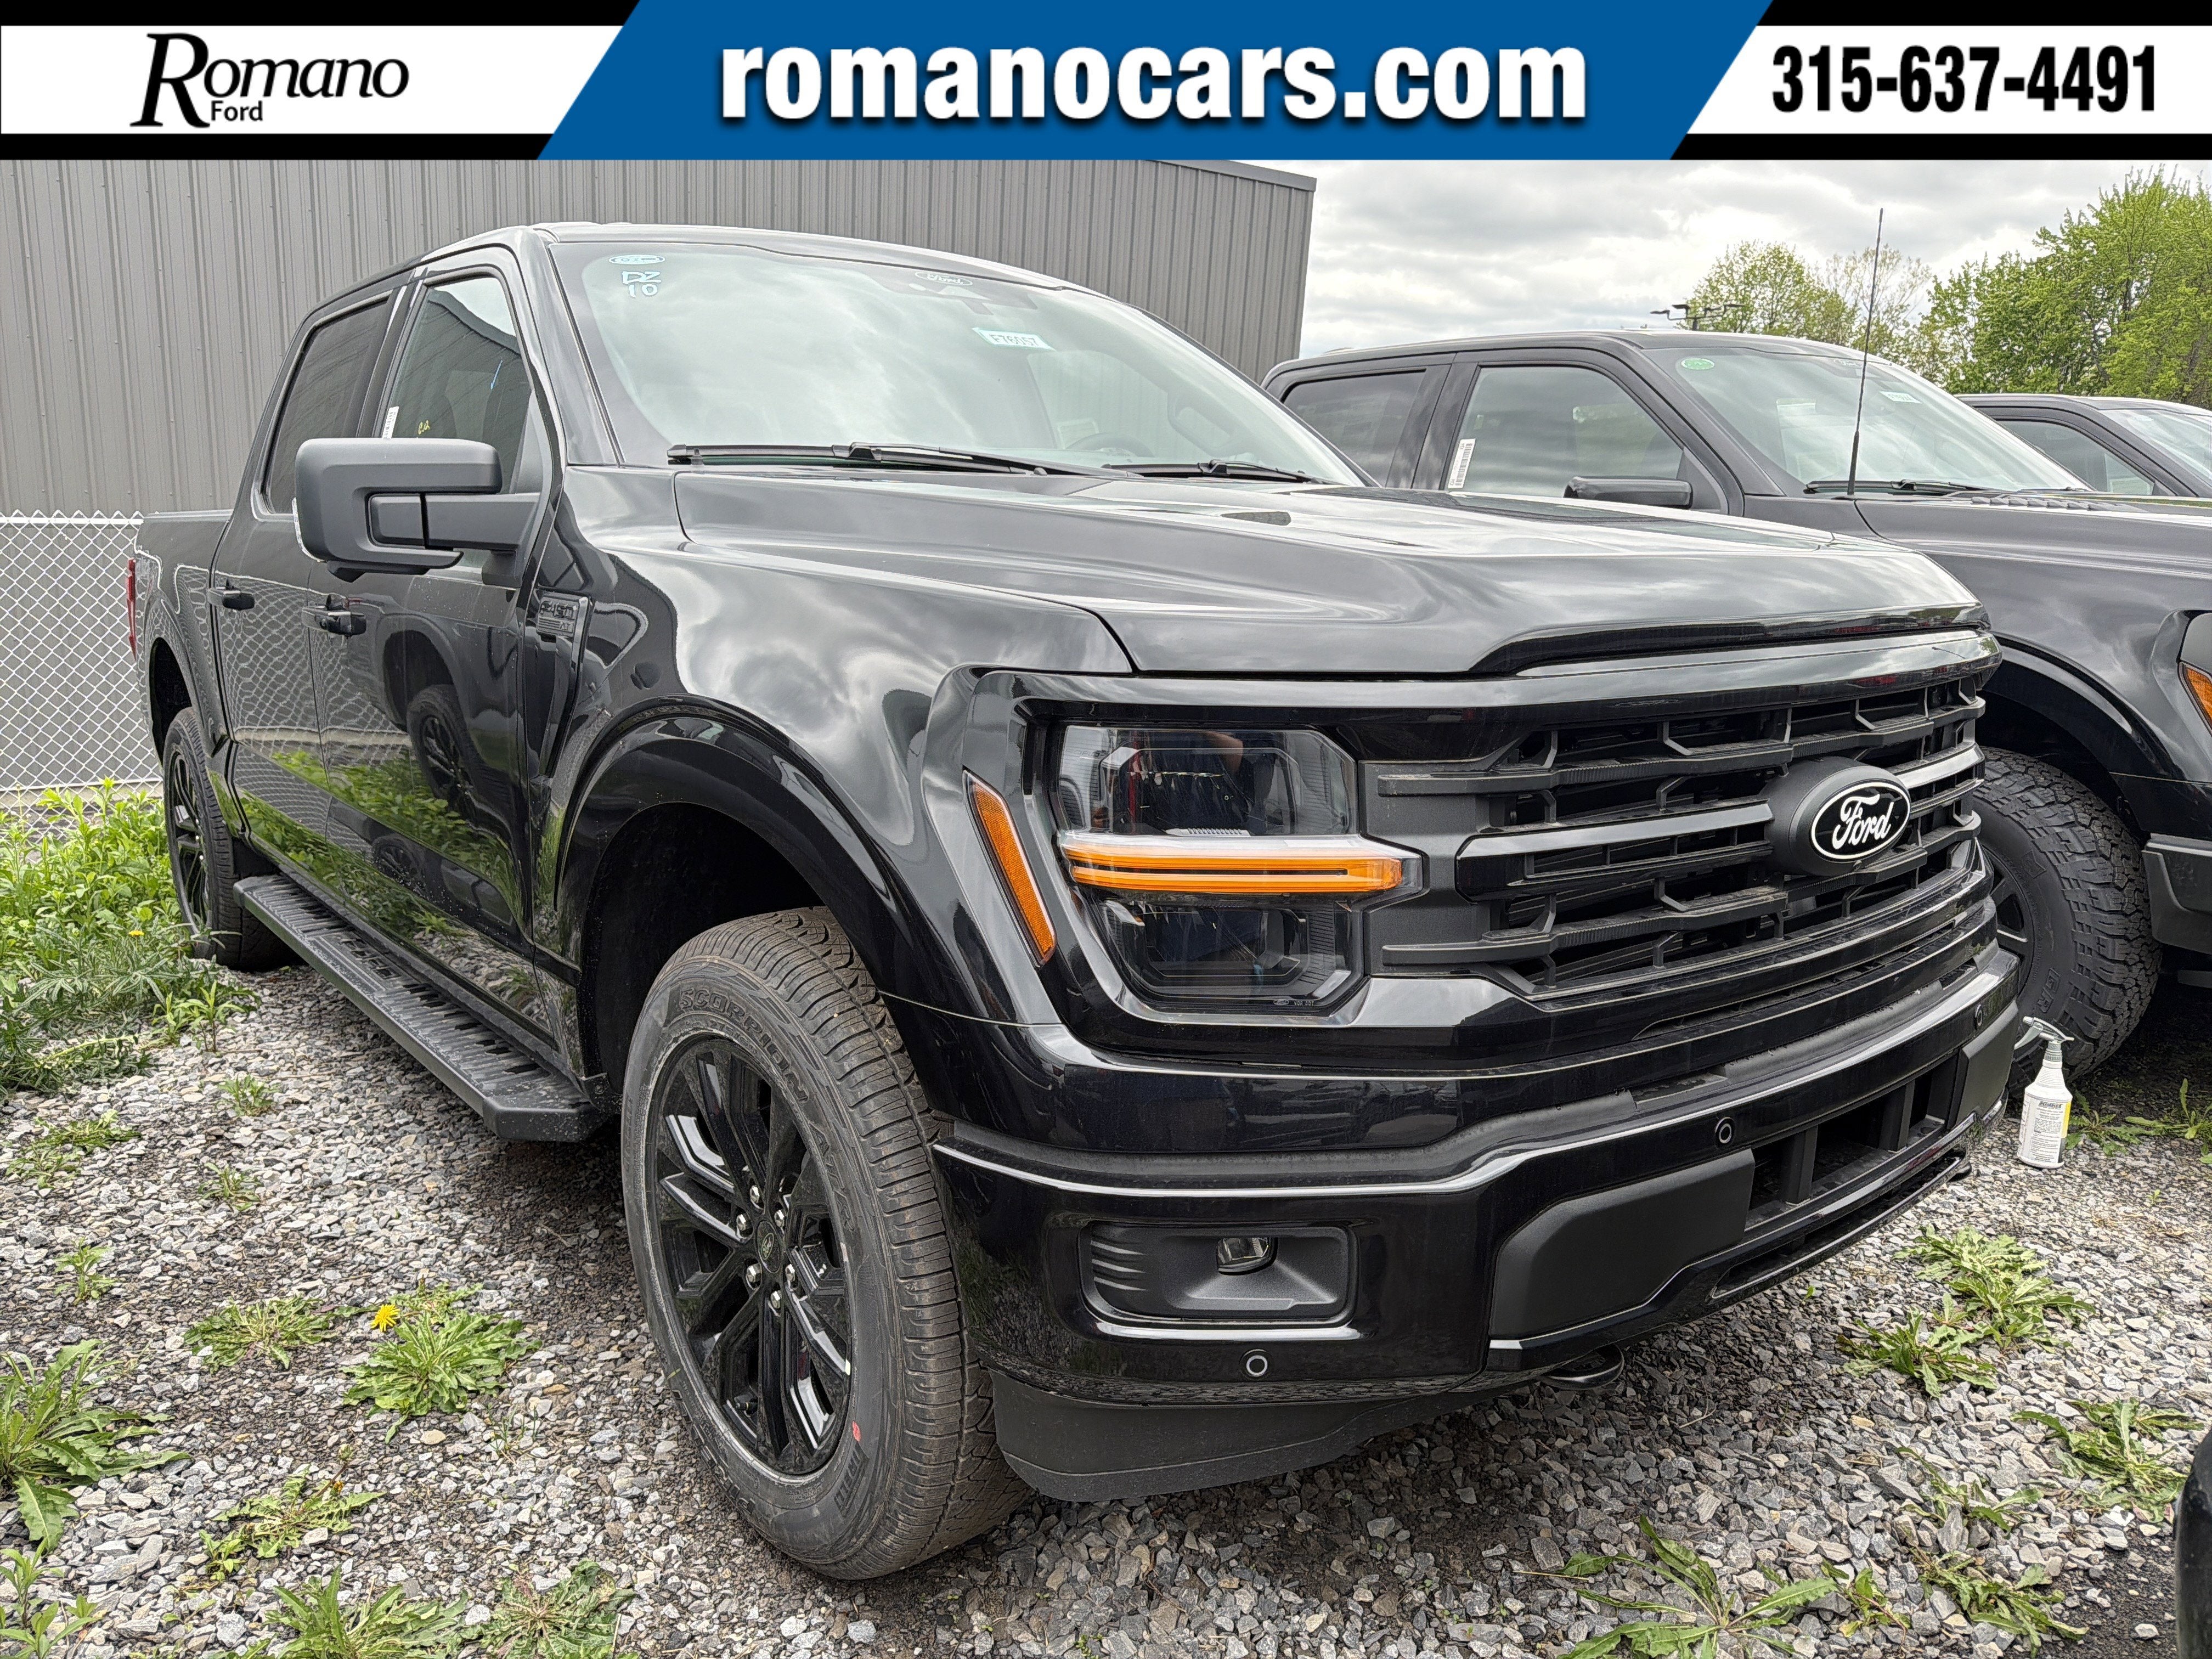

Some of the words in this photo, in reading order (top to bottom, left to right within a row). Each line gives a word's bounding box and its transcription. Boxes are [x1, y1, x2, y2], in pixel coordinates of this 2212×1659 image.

[1832, 793, 1895, 849] Ford
[679, 988, 809, 1102] SCORPION
[672, 1389, 755, 1515] PIRELLI
